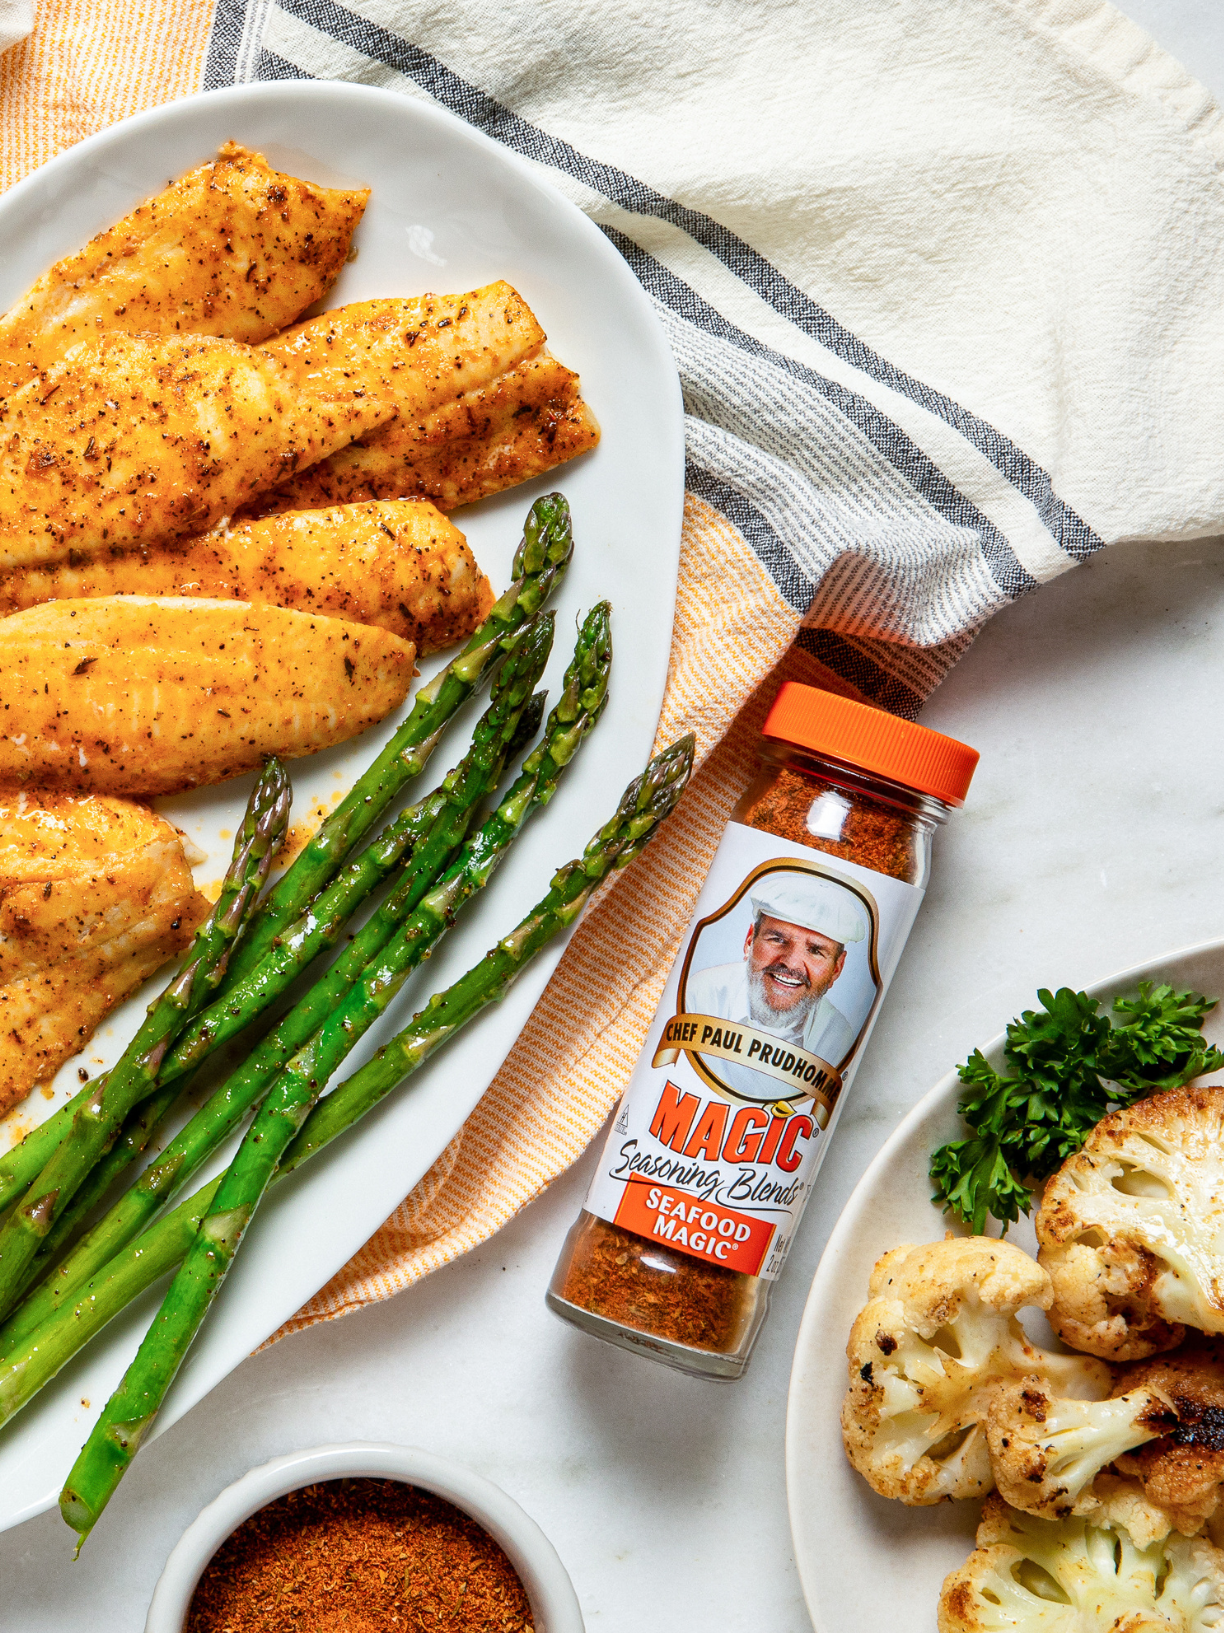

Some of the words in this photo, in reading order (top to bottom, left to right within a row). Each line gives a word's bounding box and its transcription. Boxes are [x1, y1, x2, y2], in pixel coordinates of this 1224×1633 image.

[666, 1023, 698, 1042] CHEF
[701, 1025, 743, 1058] PAUL
[747, 1040, 841, 1104] PRUDHOMME
[614, 1139, 725, 1203] Seasoning
[645, 1187, 752, 1243] SEAFOOD
